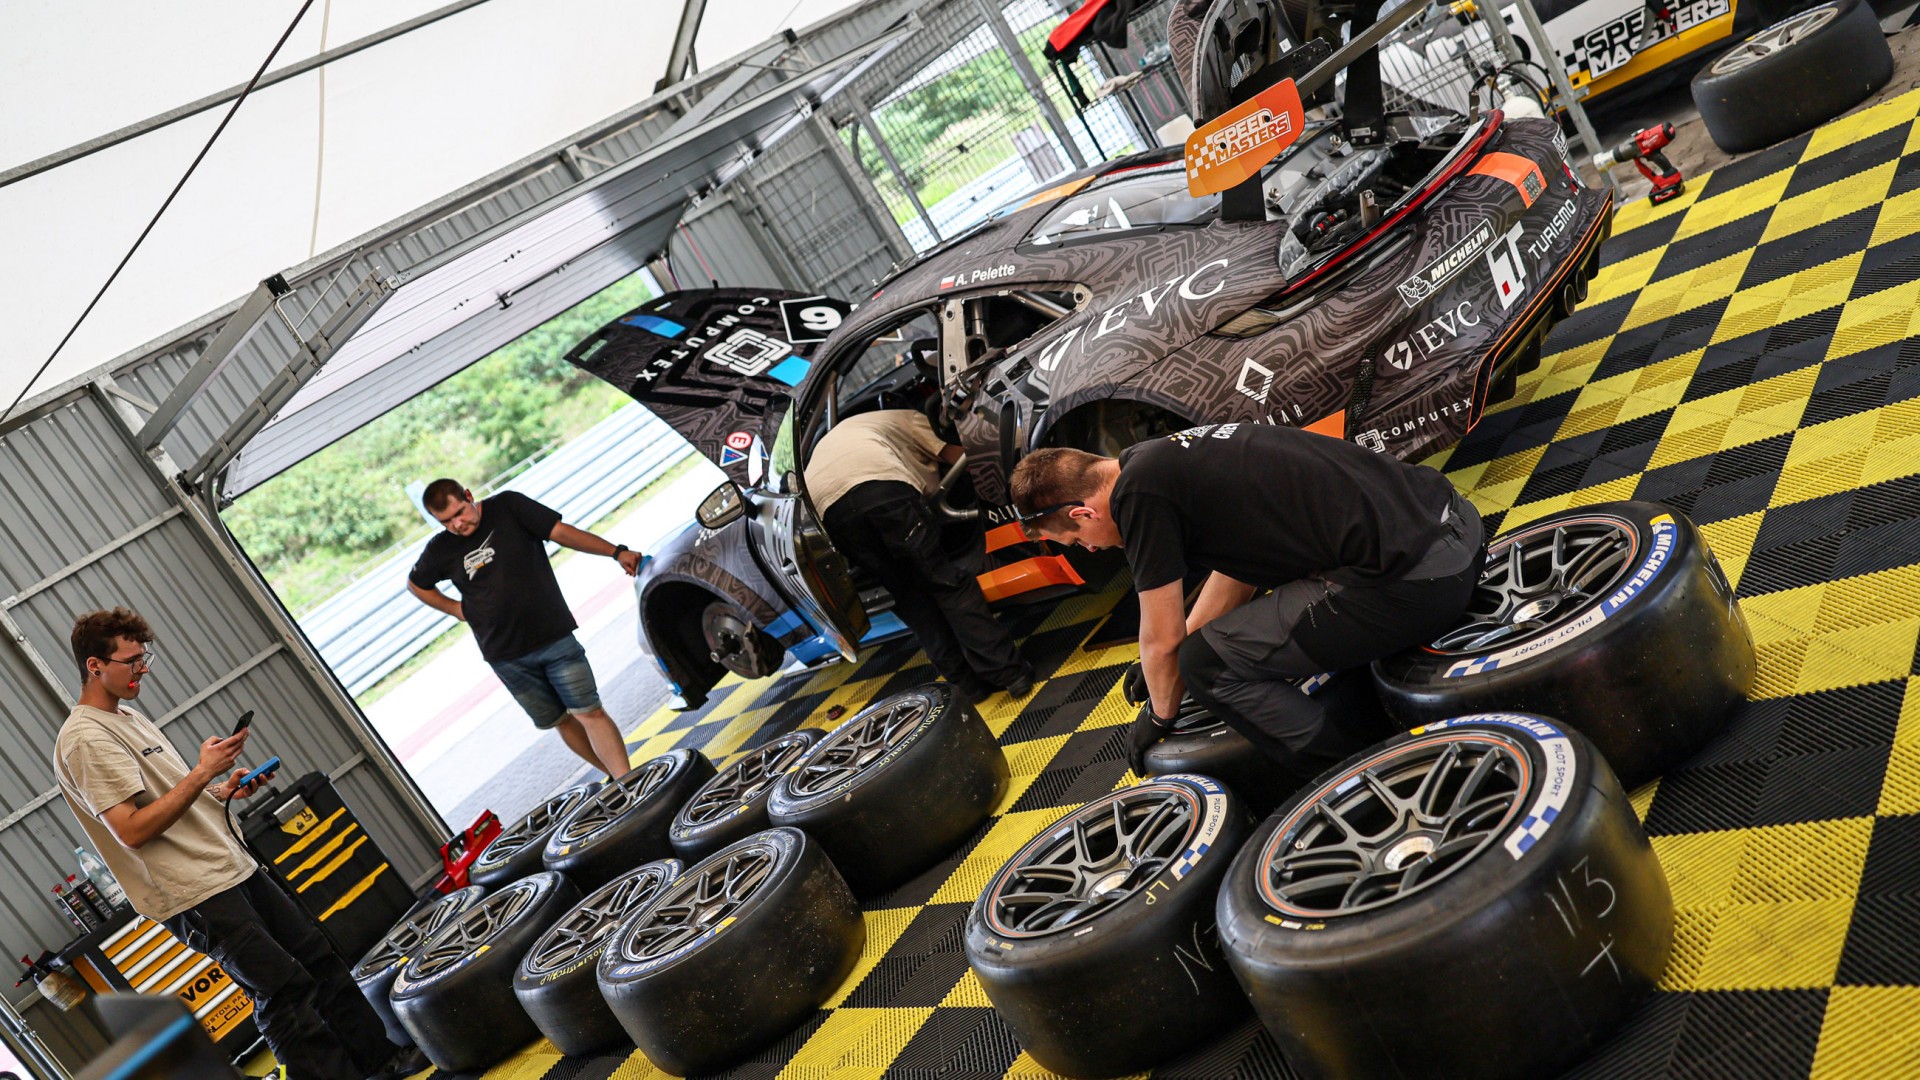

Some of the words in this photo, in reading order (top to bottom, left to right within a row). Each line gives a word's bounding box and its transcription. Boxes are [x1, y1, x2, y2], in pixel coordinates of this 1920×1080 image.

[1213, 110, 1272, 146] SPEED
[1215, 116, 1288, 161] MASTERS
[1528, 199, 1577, 260] TURISMO
[1430, 226, 1490, 283] MICHELIN
[955, 273, 968, 287] A.
[971, 264, 1016, 284] Pelette
[1092, 259, 1229, 341] EVC
[636, 297, 770, 382] COMPUTEX
[1416, 300, 1481, 354] EVC
[1380, 398, 1473, 440] COMPUTEX
[1609, 533, 1673, 609] MICHELIN
[1557, 615, 1594, 640] PILOT
[1511, 635, 1555, 658] SPORT
[1451, 713, 1556, 737] MICHELIN
[1554, 743, 1566, 765] PILOT
[1156, 773, 1220, 793] MICHELIN
[1549, 766, 1567, 797] SPORT
[1213, 798, 1221, 815] PILOT
[1206, 815, 1220, 837] SPORT
[615, 940, 695, 975] MICHELIN
[180, 967, 226, 1002] VOR
[204, 1004, 231, 1027] USTOM
